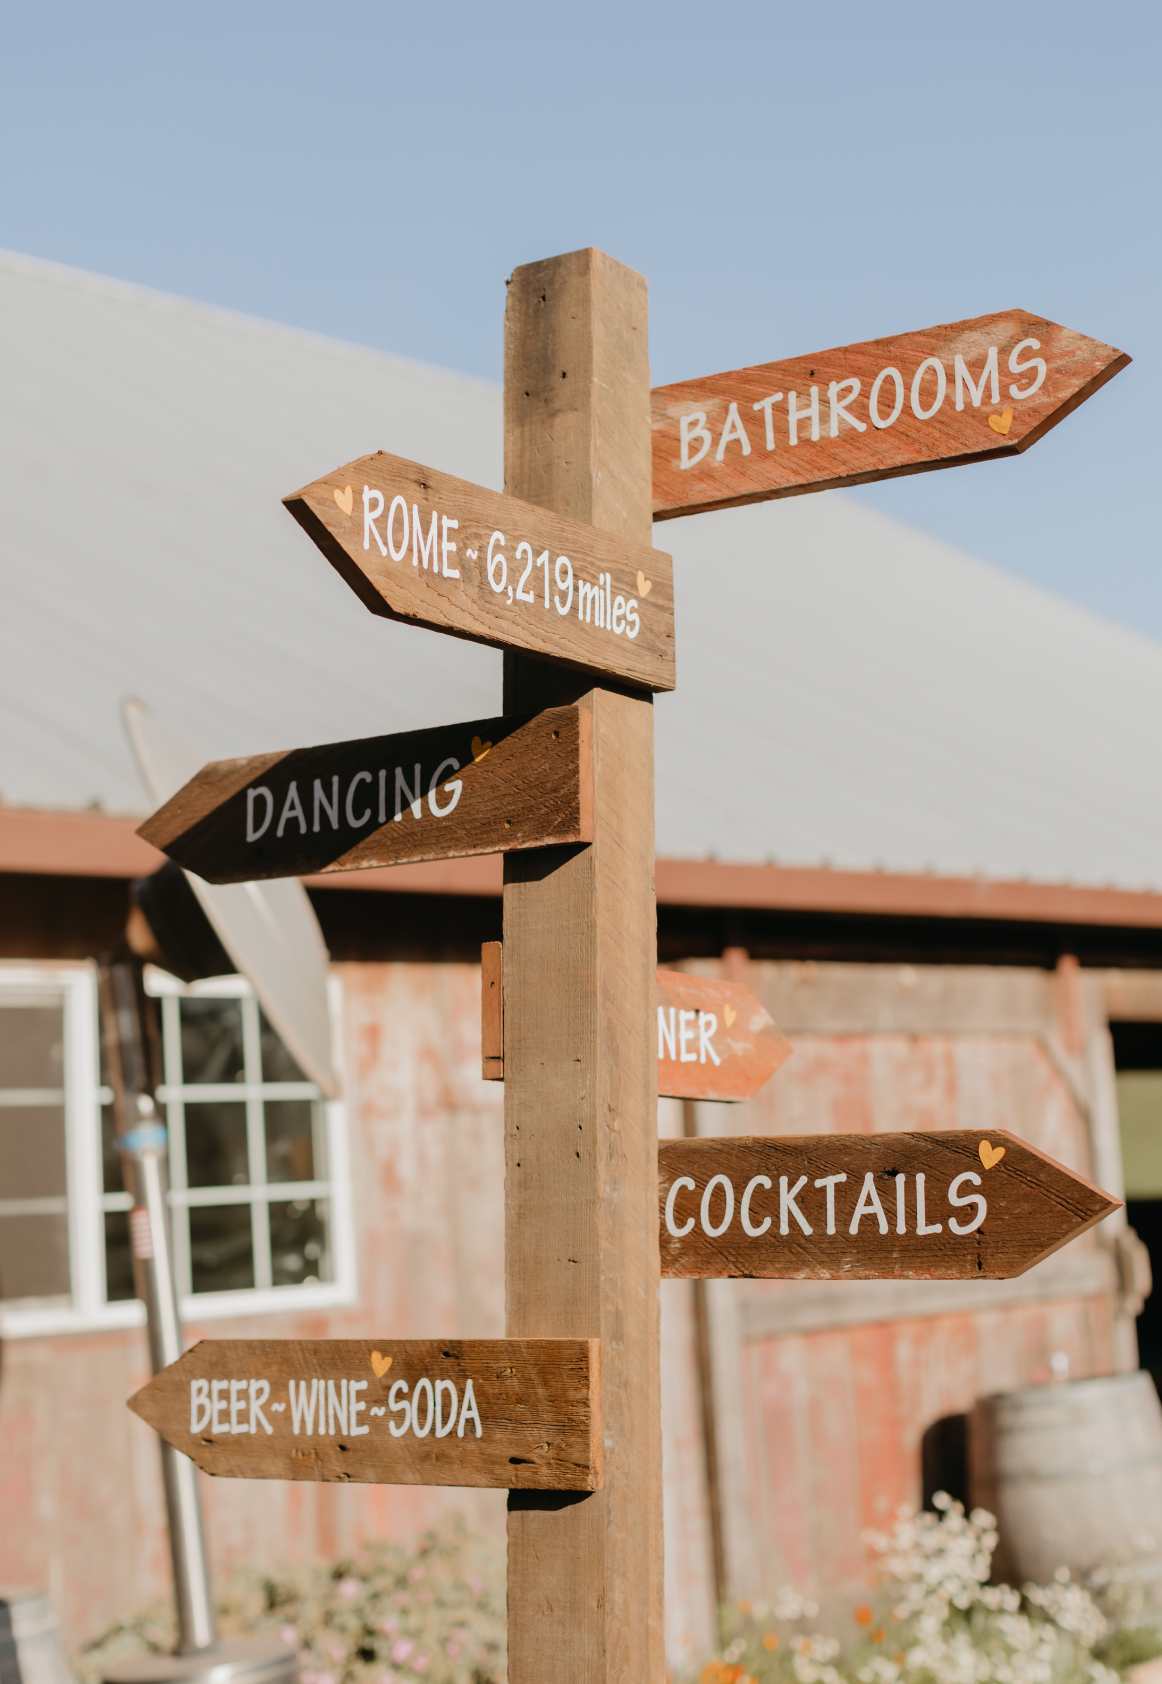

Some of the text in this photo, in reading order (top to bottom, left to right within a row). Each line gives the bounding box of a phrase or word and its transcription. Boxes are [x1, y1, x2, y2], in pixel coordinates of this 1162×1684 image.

[680, 338, 1047, 470] BATHROOMS
[362, 484, 460, 579] ROME
[486, 530, 574, 616] 6,219
[577, 572, 641, 639] miles
[246, 757, 463, 843] DANCING
[657, 1005, 721, 1066] NER
[664, 1171, 987, 1238] COCKTAILS
